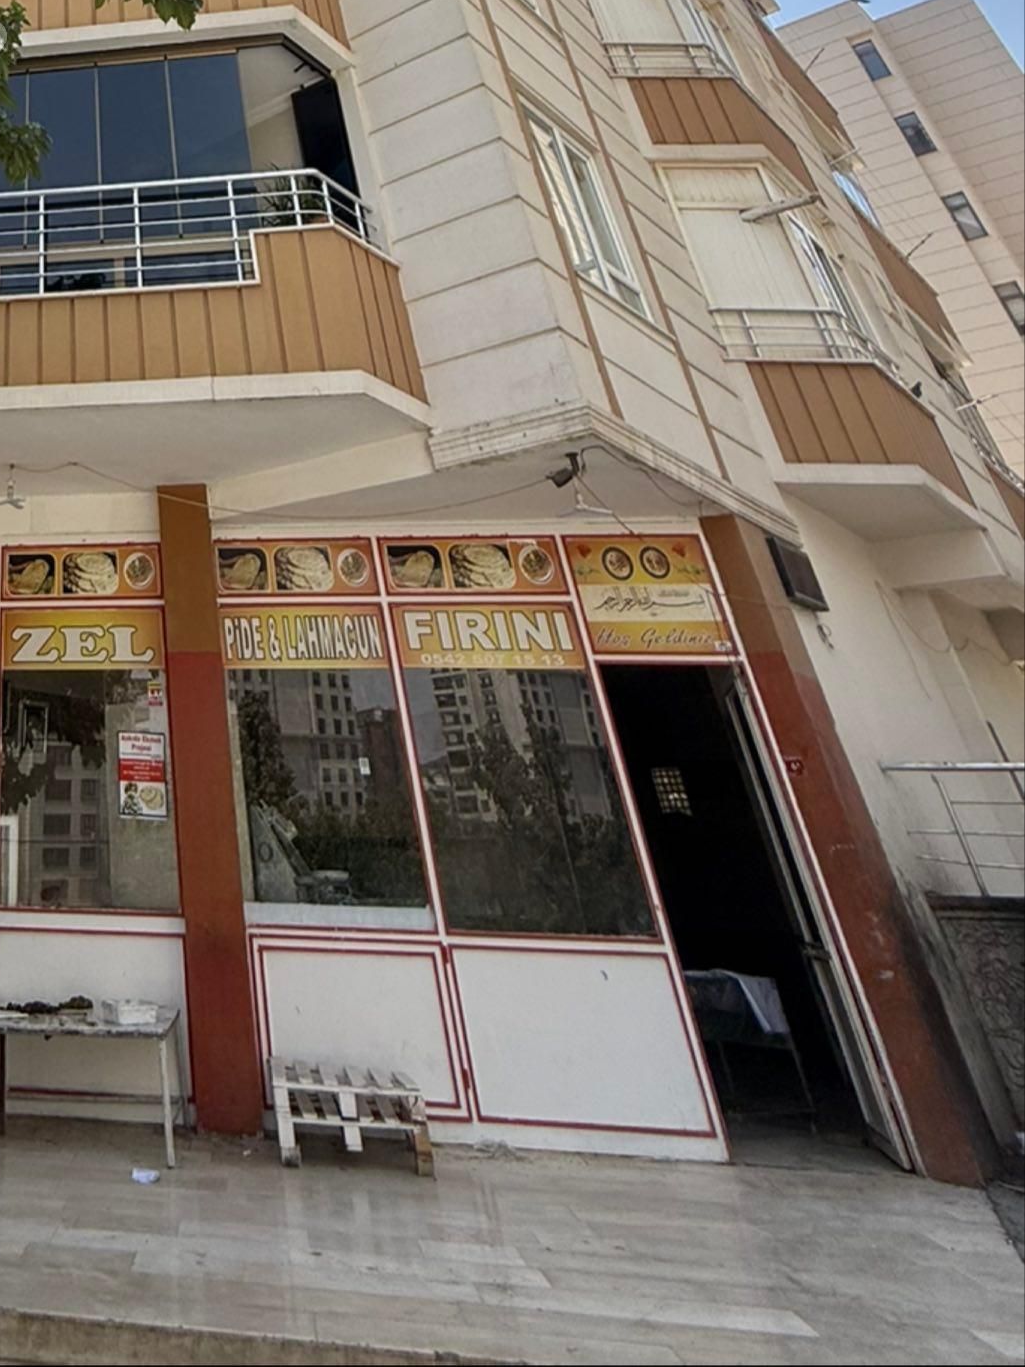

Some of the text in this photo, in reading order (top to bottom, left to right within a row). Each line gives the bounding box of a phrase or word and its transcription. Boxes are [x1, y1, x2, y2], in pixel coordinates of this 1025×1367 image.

[267, 615, 283, 662] &
[281, 615, 384, 660] LAHMACUN
[403, 610, 575, 651] FIRINI
[542, 654, 565, 666] 13
